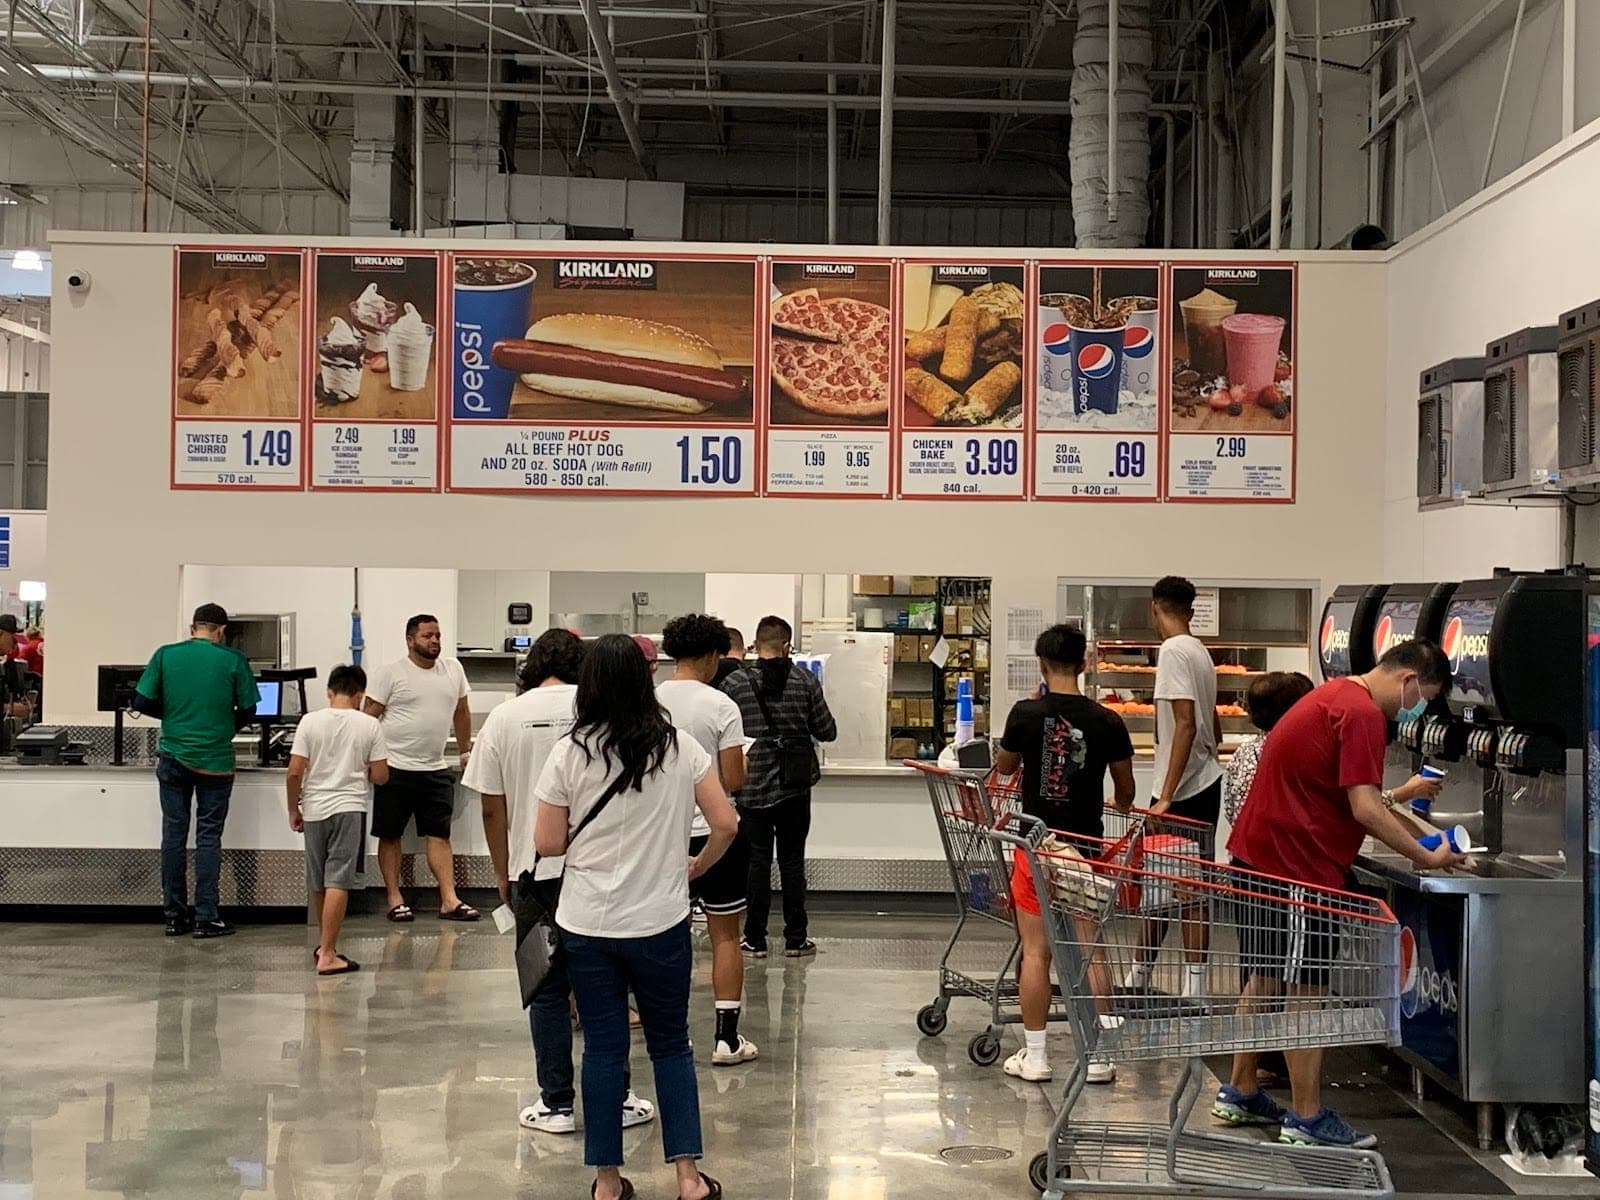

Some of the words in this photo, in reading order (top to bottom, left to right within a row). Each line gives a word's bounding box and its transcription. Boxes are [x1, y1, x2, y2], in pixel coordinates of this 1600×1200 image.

[215, 253, 265, 263] KIRKLAND
[355, 256, 404, 266] KIRKLAND
[559, 261, 654, 279] KIRKLAND
[806, 264, 854, 274] KIRKLAND
[939, 266, 988, 276] KIRKLAND
[1208, 269, 1257, 279] KIRKLAND
[456, 322, 491, 412] pepsi
[186, 434, 228, 444] TWISTED
[335, 427, 359, 444] 2.49
[392, 428, 416, 445] 1.99
[531, 431, 565, 441] POUND
[568, 430, 611, 442] PLUS
[187, 444, 227, 454] CHURRO
[242, 429, 292, 466] 1.49
[505, 443, 528, 456] ALL
[532, 444, 563, 456] BEEF
[568, 444, 593, 456] HOT
[597, 444, 624, 457] DOG
[912, 439, 953, 449] CHICKEN
[1055, 444, 1067, 454] 20
[1069, 446, 1081, 454] oz.
[1216, 437, 1246, 458] 2.99
[676, 435, 742, 485] 1.50
[804, 450, 826, 467] 1.99
[846, 451, 870, 468] 9.95
[920, 450, 945, 460] BAKE
[966, 438, 1018, 475] 3.99
[1055, 454, 1081, 464] SODA
[1109, 441, 1145, 478] .69
[481, 458, 508, 470] AND
[511, 458, 526, 471] 20
[531, 461, 548, 471] oz.
[553, 458, 587, 472] SODA
[591, 460, 619, 473] (With
[621, 461, 652, 474] Refill)
[217, 473, 236, 484] 570
[238, 474, 257, 484] cal.
[525, 473, 547, 486] 580
[561, 473, 583, 487] 850
[587, 473, 609, 487] cal.
[943, 483, 961, 493] 840
[963, 483, 981, 493] cal.
[1103, 485, 1120, 495] cal.
[1461, 630, 1489, 661] pepsi
[1421, 967, 1457, 1015] peps
